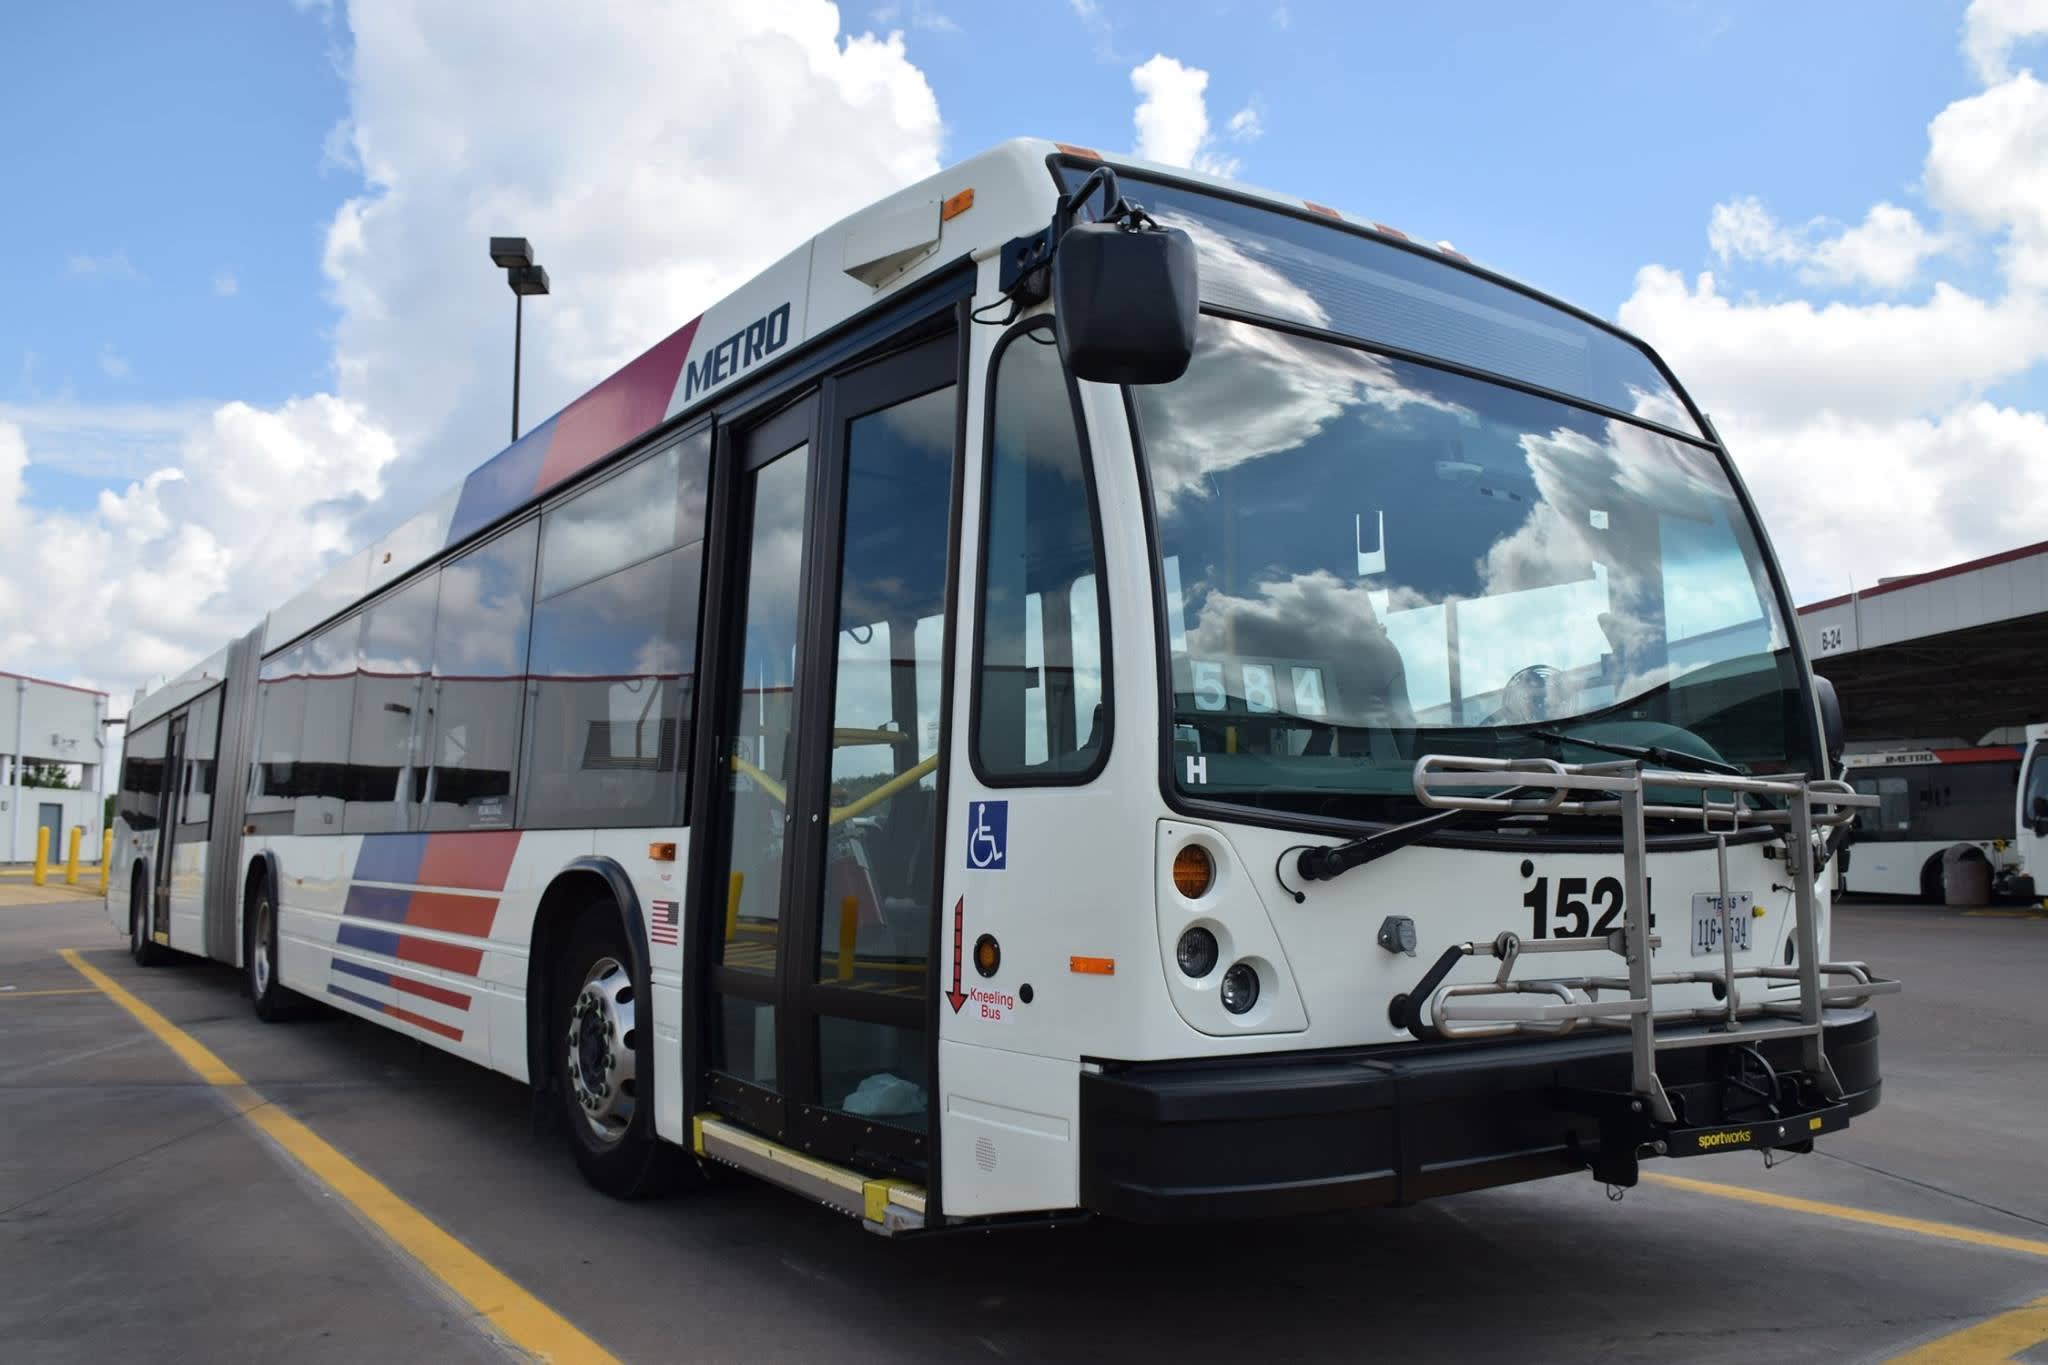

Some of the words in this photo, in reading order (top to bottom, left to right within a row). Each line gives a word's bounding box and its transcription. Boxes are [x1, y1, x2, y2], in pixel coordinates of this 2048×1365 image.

[684, 301, 791, 403] METRO
[1821, 628, 1842, 651] B-24
[1186, 755, 1207, 785] H
[1711, 897, 1737, 910] TES
[970, 987, 1014, 1010] Kneeling
[981, 1004, 1001, 1020] Bus
[1698, 1130, 1751, 1148] sportworks
